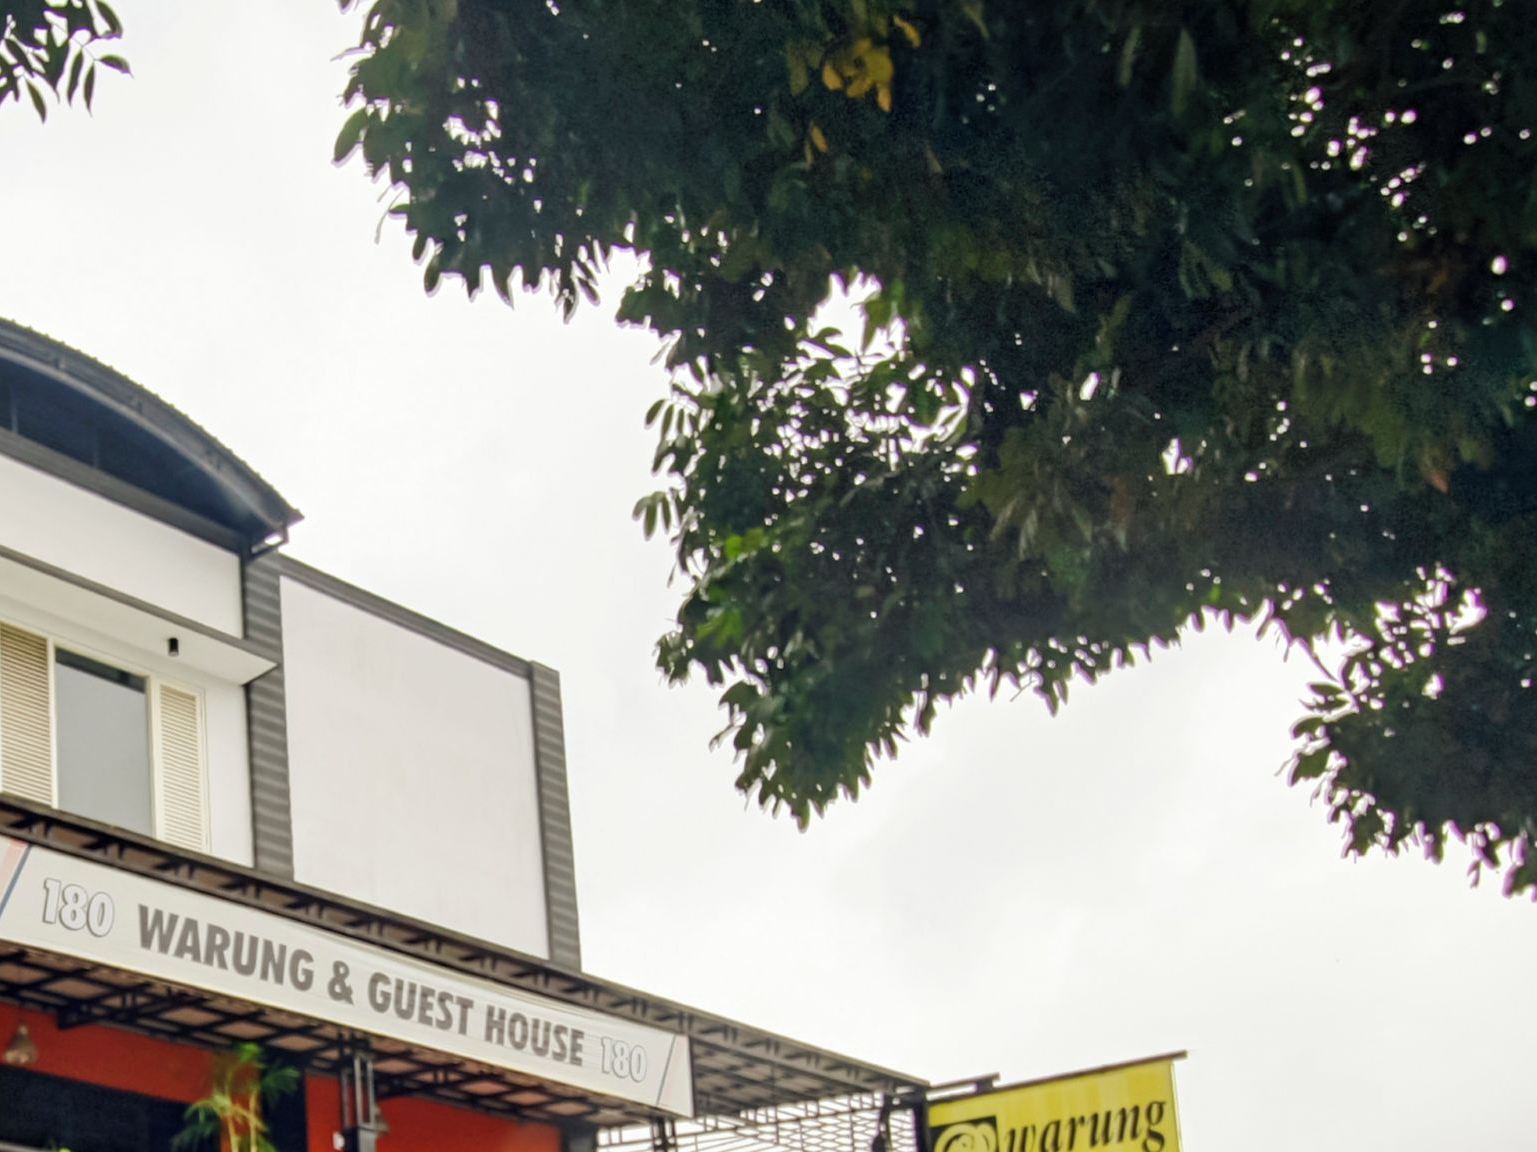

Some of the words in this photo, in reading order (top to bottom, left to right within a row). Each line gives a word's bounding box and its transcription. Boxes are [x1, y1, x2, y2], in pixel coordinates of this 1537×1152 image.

[42, 877, 114, 938] 180
[138, 903, 314, 992] WARUNG
[327, 960, 355, 1006] &
[368, 972, 474, 1036] GUEST
[484, 1004, 585, 1067] HOUSE
[601, 1036, 648, 1083] 180
